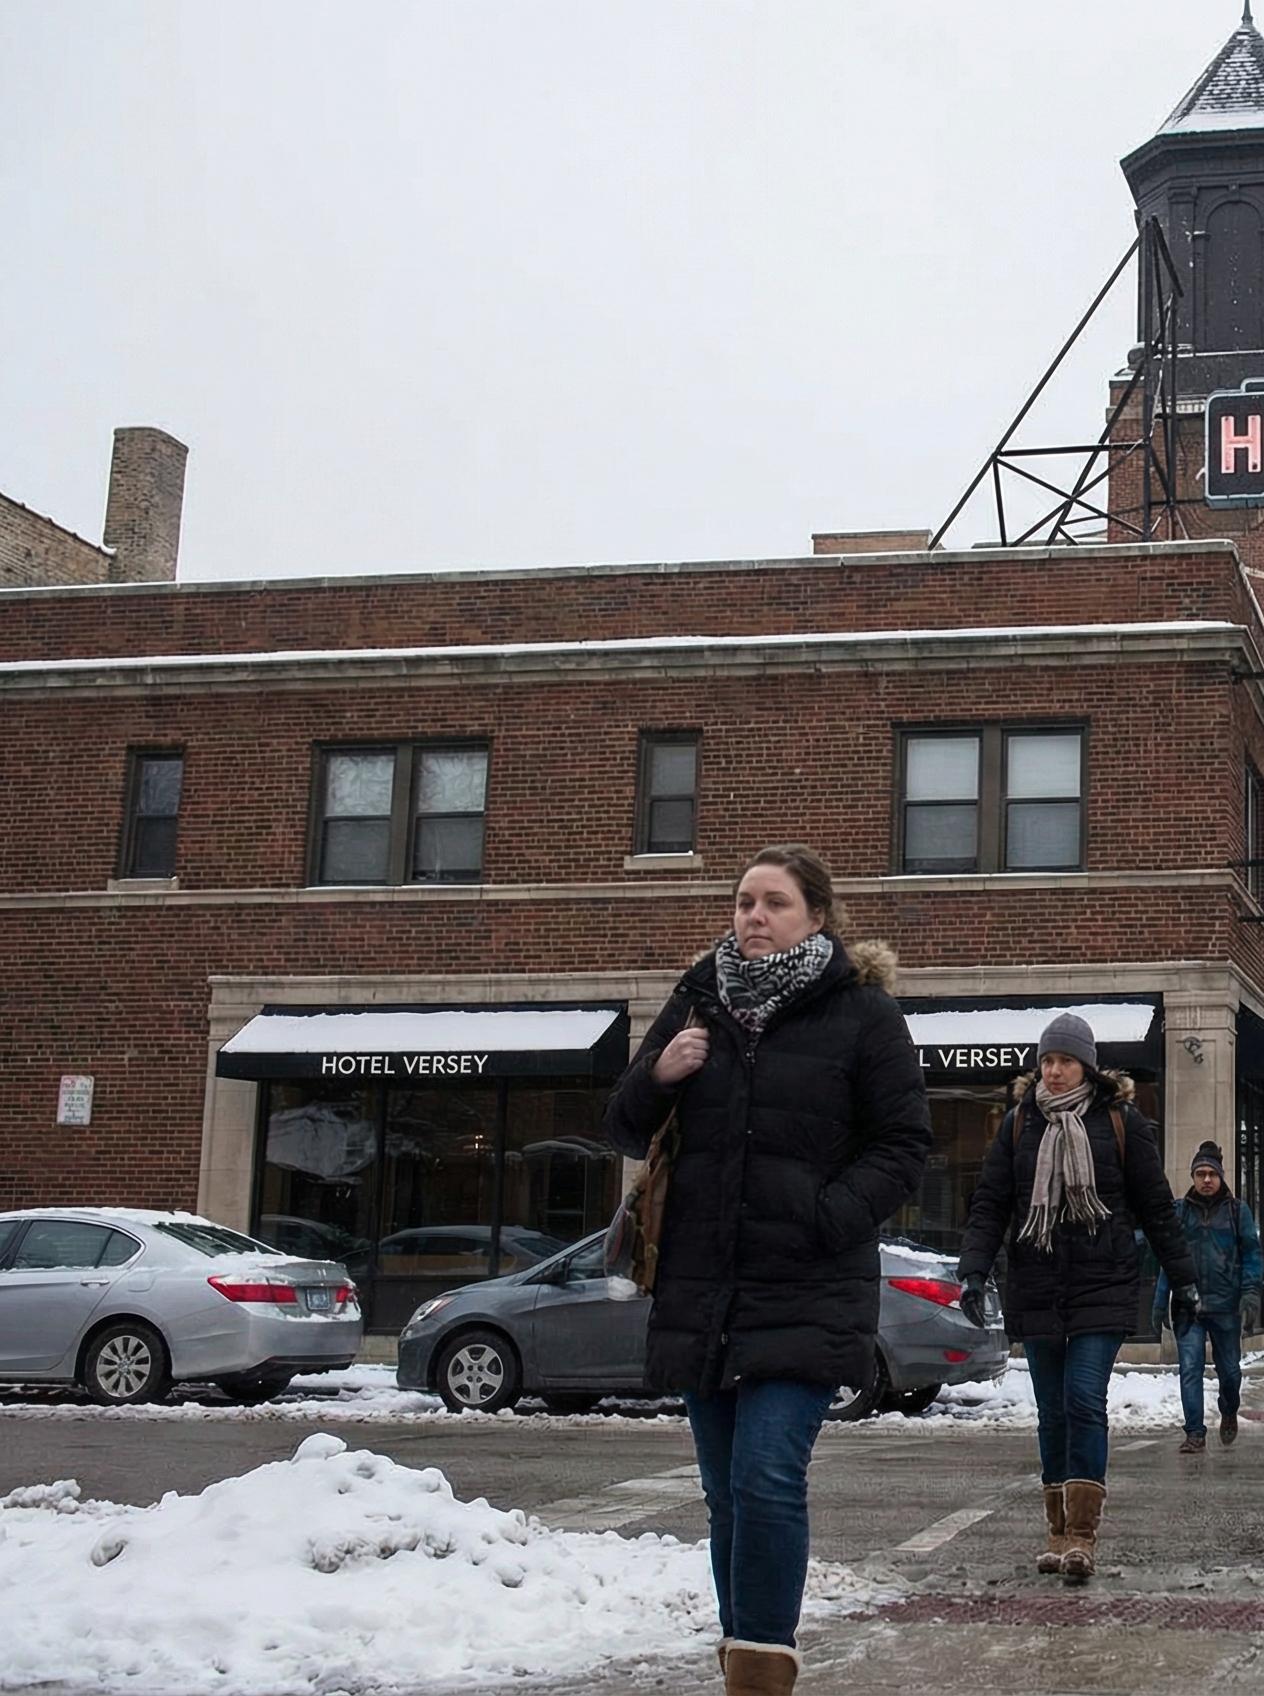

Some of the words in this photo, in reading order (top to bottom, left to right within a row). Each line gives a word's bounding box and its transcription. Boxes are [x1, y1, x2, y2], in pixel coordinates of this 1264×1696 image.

[321, 1055, 396, 1075] HOTEL
[402, 1054, 489, 1075] VERSEY
[937, 1046, 1030, 1068] VERSEY
